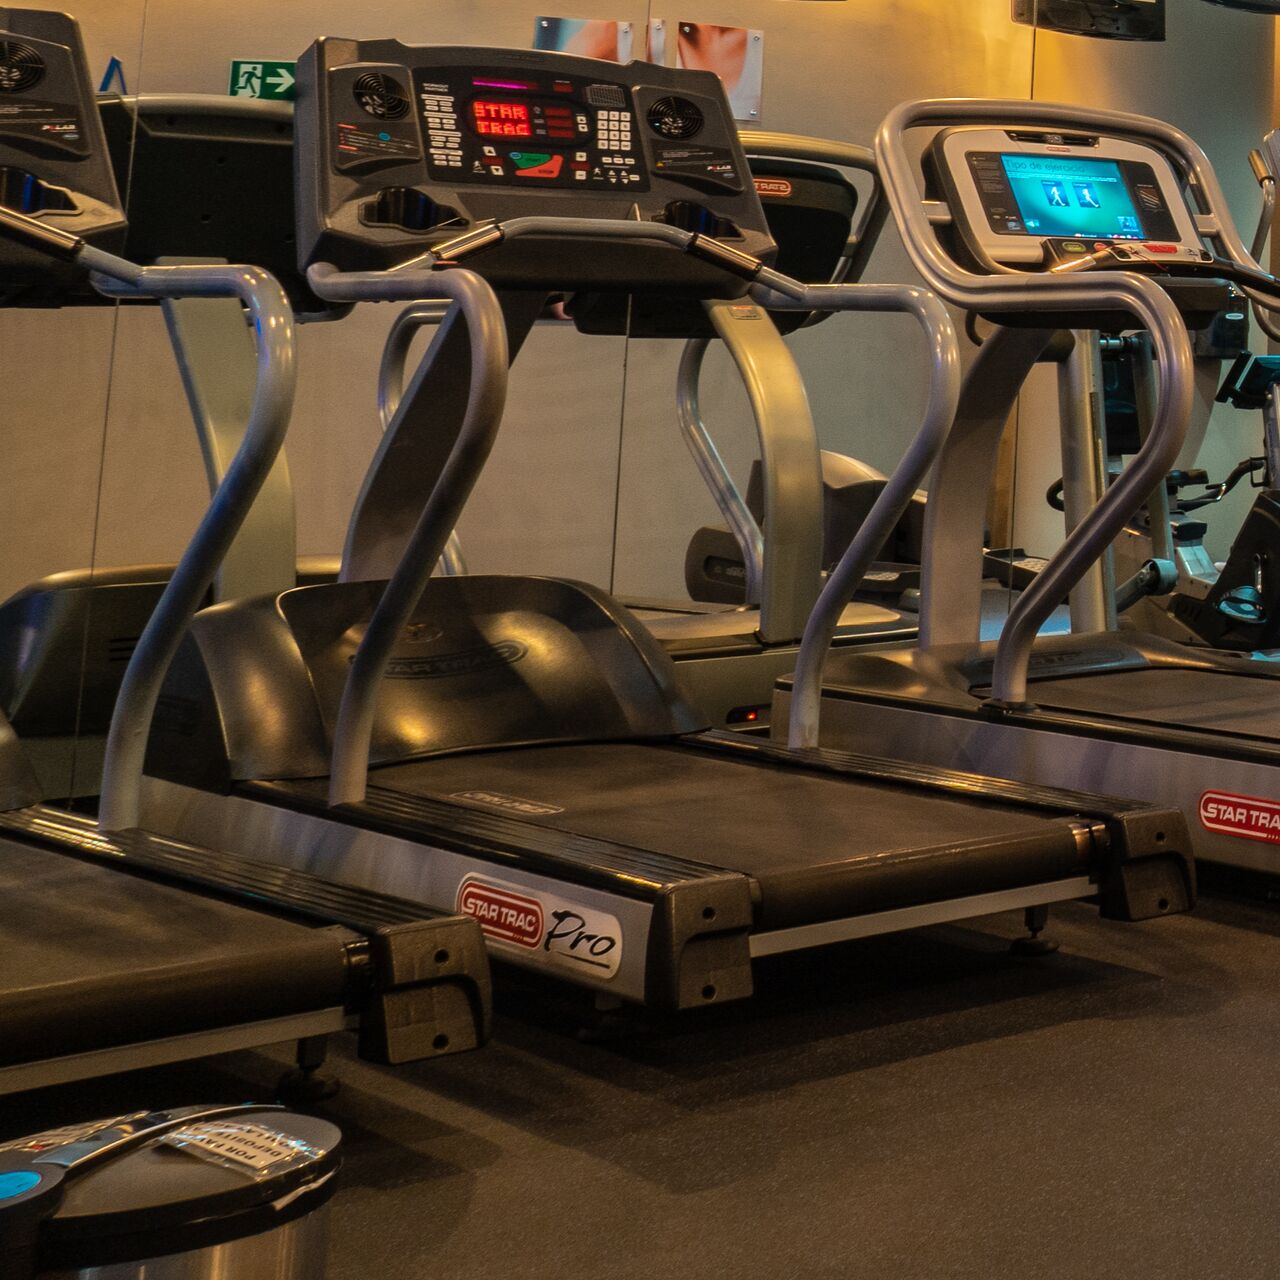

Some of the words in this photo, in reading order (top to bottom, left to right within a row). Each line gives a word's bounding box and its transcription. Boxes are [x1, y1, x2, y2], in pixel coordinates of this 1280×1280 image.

[473, 101, 527, 120] STAR
[1203, 803, 1247, 824] STAR
[464, 898, 499, 921] STAR
[500, 907, 536, 932] TRAC
[544, 910, 617, 956] Pro
